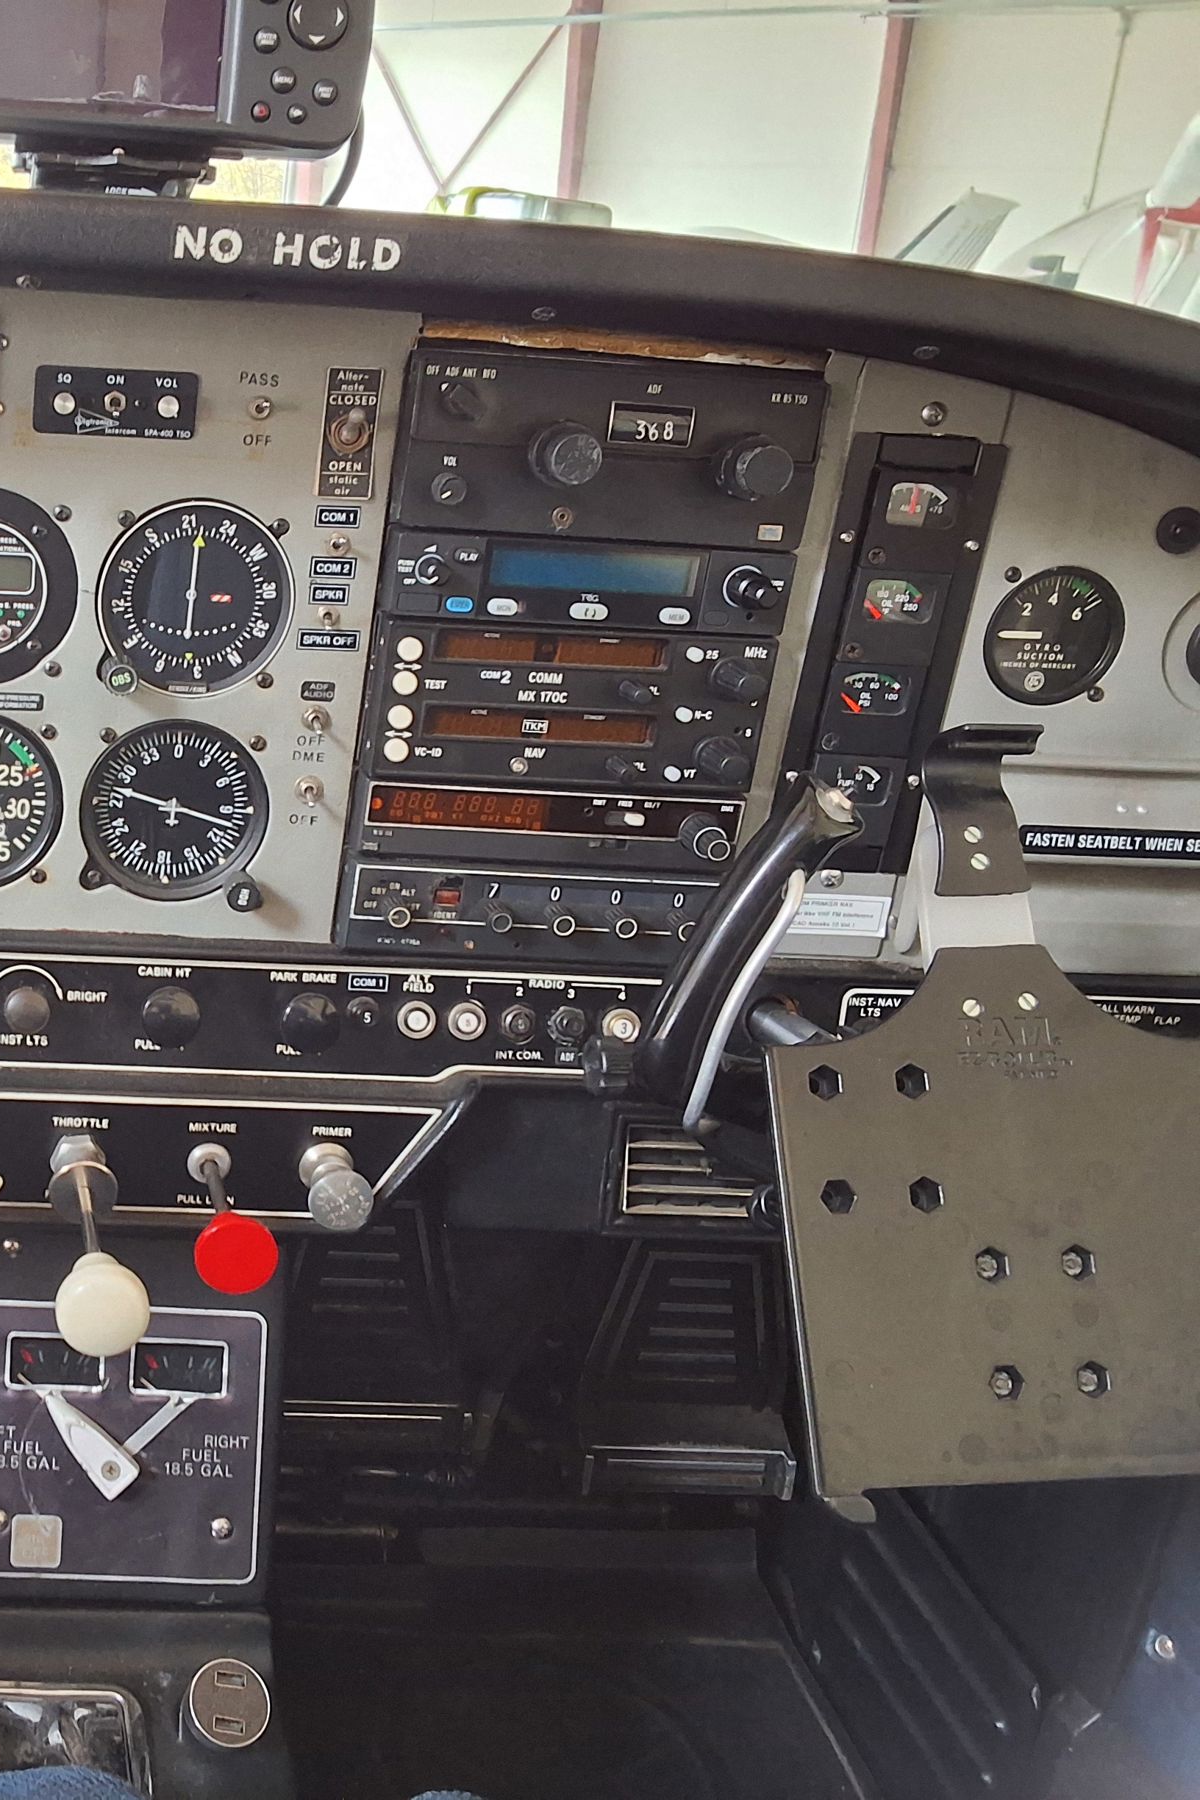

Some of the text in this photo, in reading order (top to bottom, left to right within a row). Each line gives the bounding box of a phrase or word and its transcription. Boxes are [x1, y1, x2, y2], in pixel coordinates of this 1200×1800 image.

[275, 76, 294, 84] MENU
[104, 185, 128, 196] LOCK
[173, 225, 401, 271] NO HOLD
[337, 370, 369, 381] Alter-
[426, 364, 440, 375] OFF
[445, 366, 459, 377] ADF
[462, 367, 477, 378] ANT
[57, 373, 72, 384] SQ
[107, 375, 125, 385] ON
[155, 377, 178, 388] VOL
[239, 371, 280, 388] PASS
[647, 384, 663, 394] ADF
[329, 395, 377, 406] CLOSED
[105, 428, 137, 436] Intercom
[635, 419, 674, 441] 368
[243, 434, 273, 447] OFF
[328, 461, 362, 471] OPEN
[443, 455, 457, 467] VOL
[329, 475, 358, 485] static
[334, 487, 350, 496] air
[181, 514, 197, 529] 21
[321, 512, 354, 522] COM 1
[219, 520, 237, 537] 24
[144, 528, 158, 544] S
[249, 542, 268, 562] W
[460, 552, 479, 562] PLAY
[118, 558, 134, 574] 15
[316, 563, 350, 574] COM 2
[262, 581, 277, 599] 30
[315, 590, 344, 600] SPKR
[112, 598, 126, 614] 12
[1022, 603, 1032, 617] 2
[1071, 607, 1083, 621] 6
[252, 619, 270, 638] 33
[122, 633, 139, 649] E
[303, 635, 355, 646] SPKR OFF
[744, 646, 768, 659] MHz
[1024, 643, 1061, 652] GYRO
[226, 650, 243, 668] N
[1017, 652, 1064, 661] SUCTION
[1041, 662, 1076, 670] MERCURY
[111, 672, 131, 687] OBS
[528, 671, 563, 685] COMM
[309, 682, 328, 690] ADF
[424, 679, 447, 690] TEST
[303, 690, 334, 699] AUDIO
[518, 690, 568, 704] MX 170C
[297, 735, 325, 746] OFF
[140, 747, 160, 766] 33
[174, 744, 183, 759] 0
[292, 751, 325, 763] DME
[414, 747, 443, 758] VC-ID
[524, 747, 546, 759] NAV
[118, 764, 137, 784] 30
[4, 798, 30, 819] 30
[111, 817, 130, 836] 24
[1025, 832, 1184, 852] FASTEN SEATBELT WHEN
[401, 888, 416, 896] ALT
[488, 883, 684, 907] 7 0 0 0
[138, 966, 192, 979] CABIN HT
[270, 971, 337, 984] PARK BRAKE
[407, 974, 431, 983] ALT
[353, 978, 383, 988] COM 1
[403, 982, 435, 993] FIELD
[528, 979, 565, 990] RADIO
[67, 991, 107, 1003] BRIGHT
[849, 997, 901, 1008] INST-NAV
[860, 1008, 881, 1017] LTS
[1123, 1005, 1155, 1015] WARN
[1154, 1016, 1181, 1026] FLAP
[26, 1034, 48, 1047] LTS
[560, 1052, 575, 1062] ADF
[52, 1116, 110, 1129] THROTTLE
[188, 1122, 237, 1134] MIXTURE
[312, 1126, 352, 1137] PRIMER
[176, 1194, 204, 1205] PULL
[4, 1440, 43, 1454] FUEL
[204, 1434, 250, 1450] RIGHT
[182, 1448, 221, 1463] FUEL
[26, 1456, 60, 1471] GAL
[164, 1462, 233, 1478] 18.5 GAL
